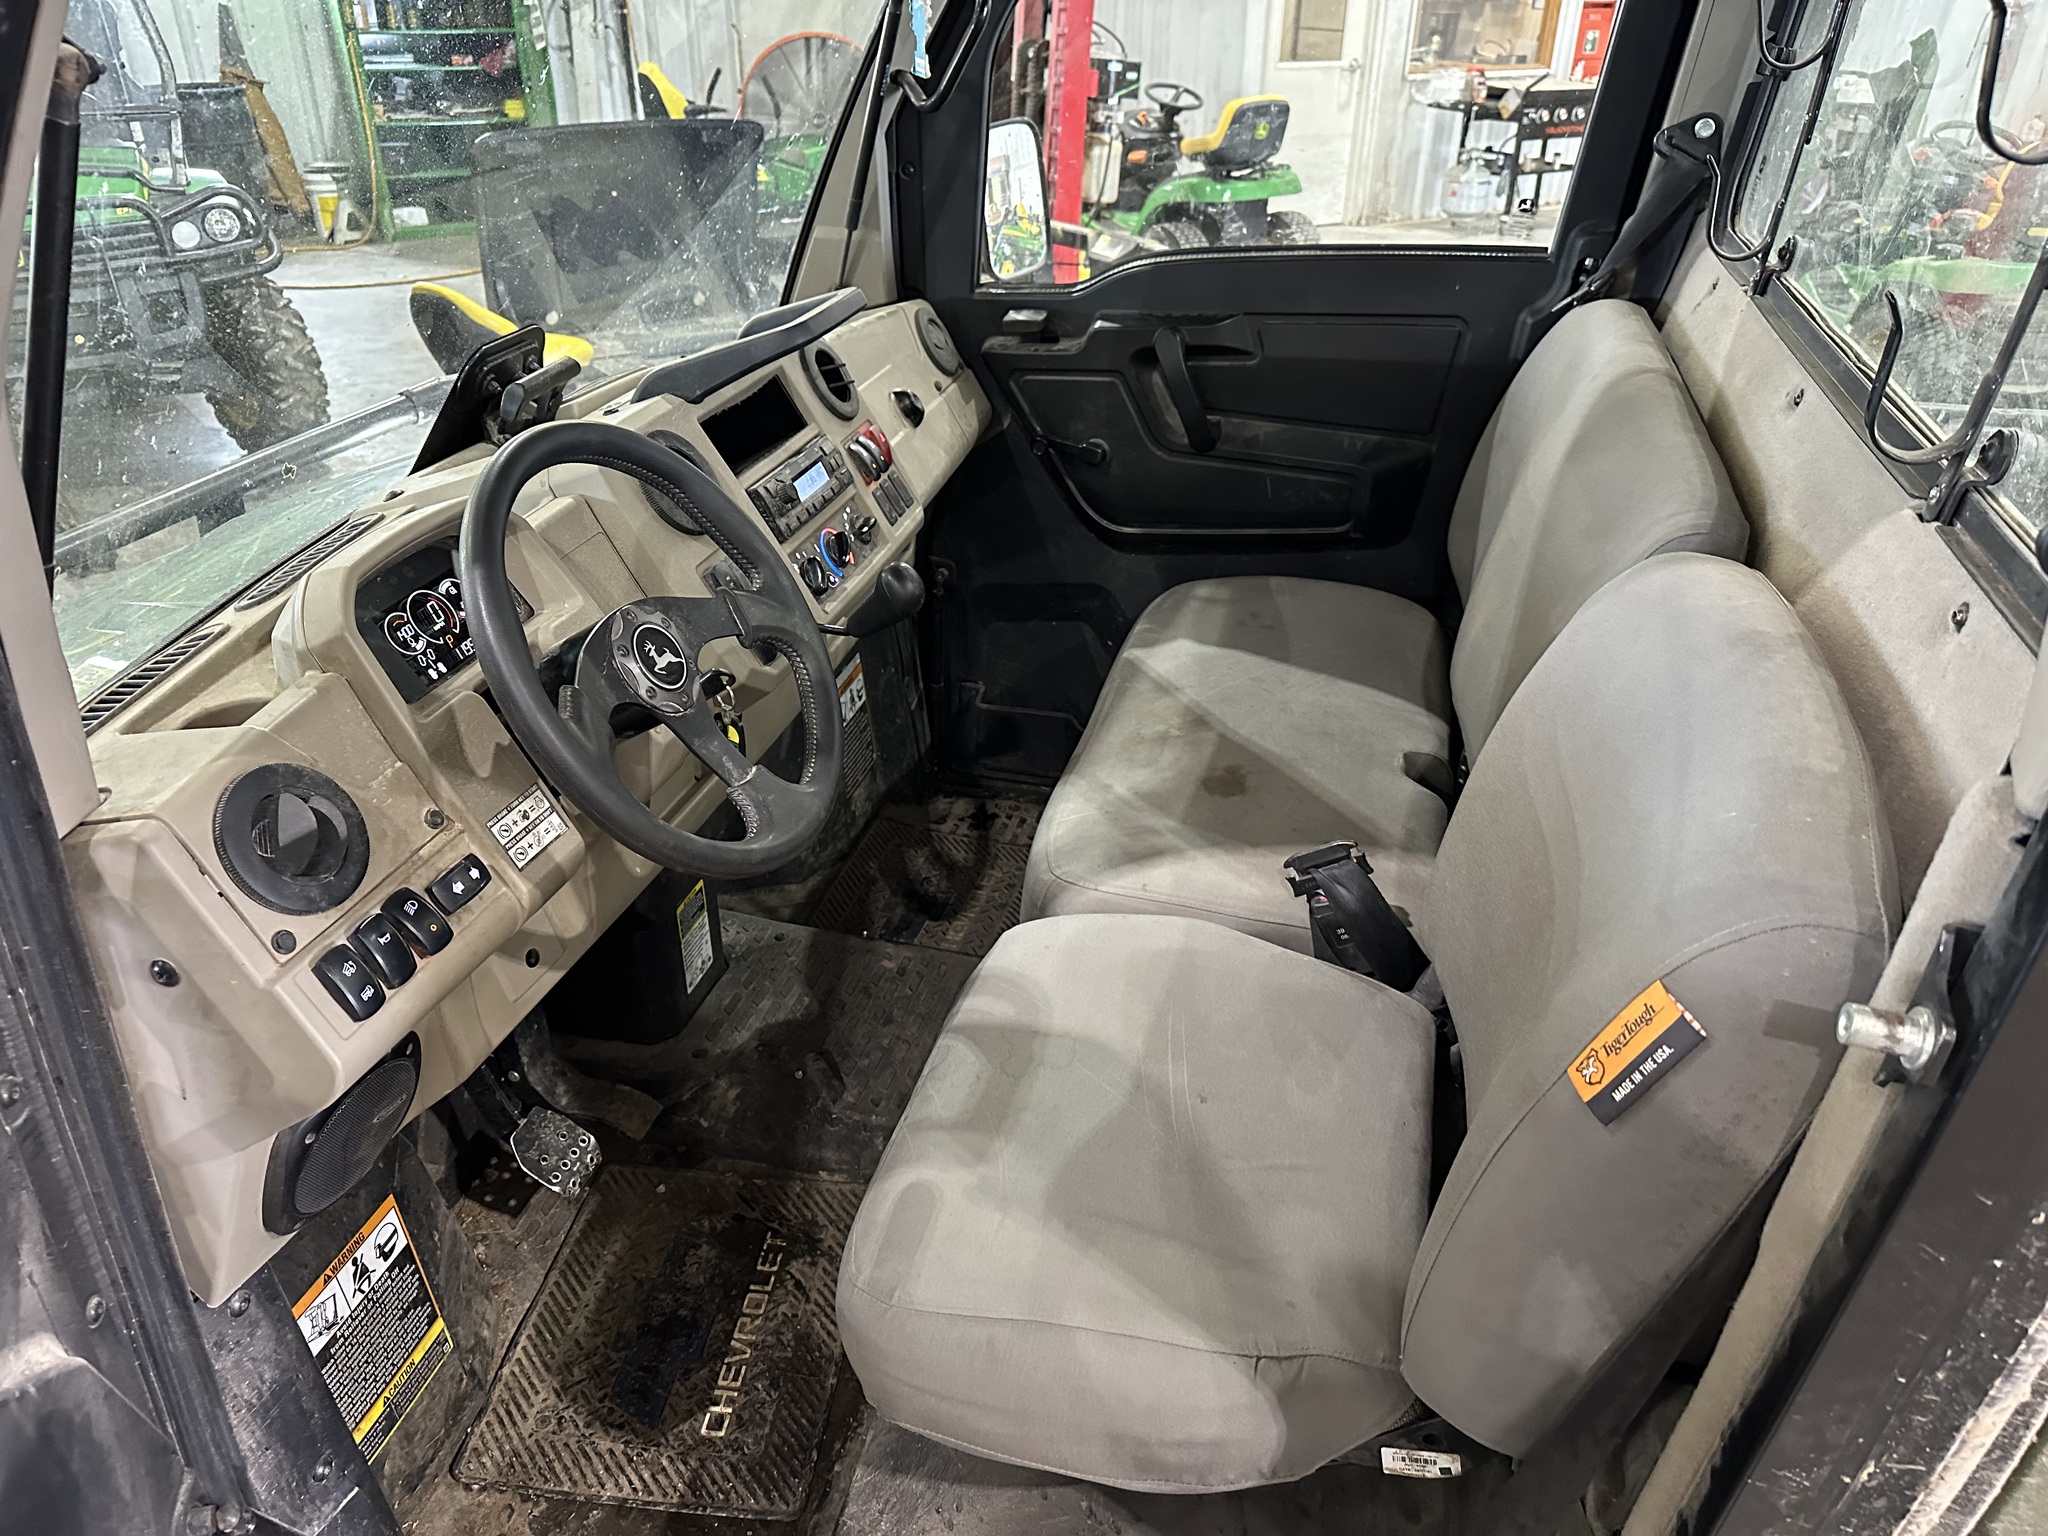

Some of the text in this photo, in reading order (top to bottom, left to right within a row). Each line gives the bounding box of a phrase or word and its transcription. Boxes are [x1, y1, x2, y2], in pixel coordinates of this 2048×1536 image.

[446, 634, 454, 648] P
[1600, 1003, 1656, 1057] TigerTough
[1611, 1044, 1675, 1103] MADE IN THE USA.
[328, 1230, 365, 1276] WARNING
[329, 1334, 344, 1355] from
[343, 1306, 367, 1338] Rollover
[372, 1276, 391, 1302] Falling
[335, 1315, 352, 1338] Avoid
[351, 1295, 368, 1319] Injury
[373, 1269, 389, 1291] Death
[700, 1231, 787, 1437] CHEVROLET
[388, 1357, 415, 1397] CAUTION
